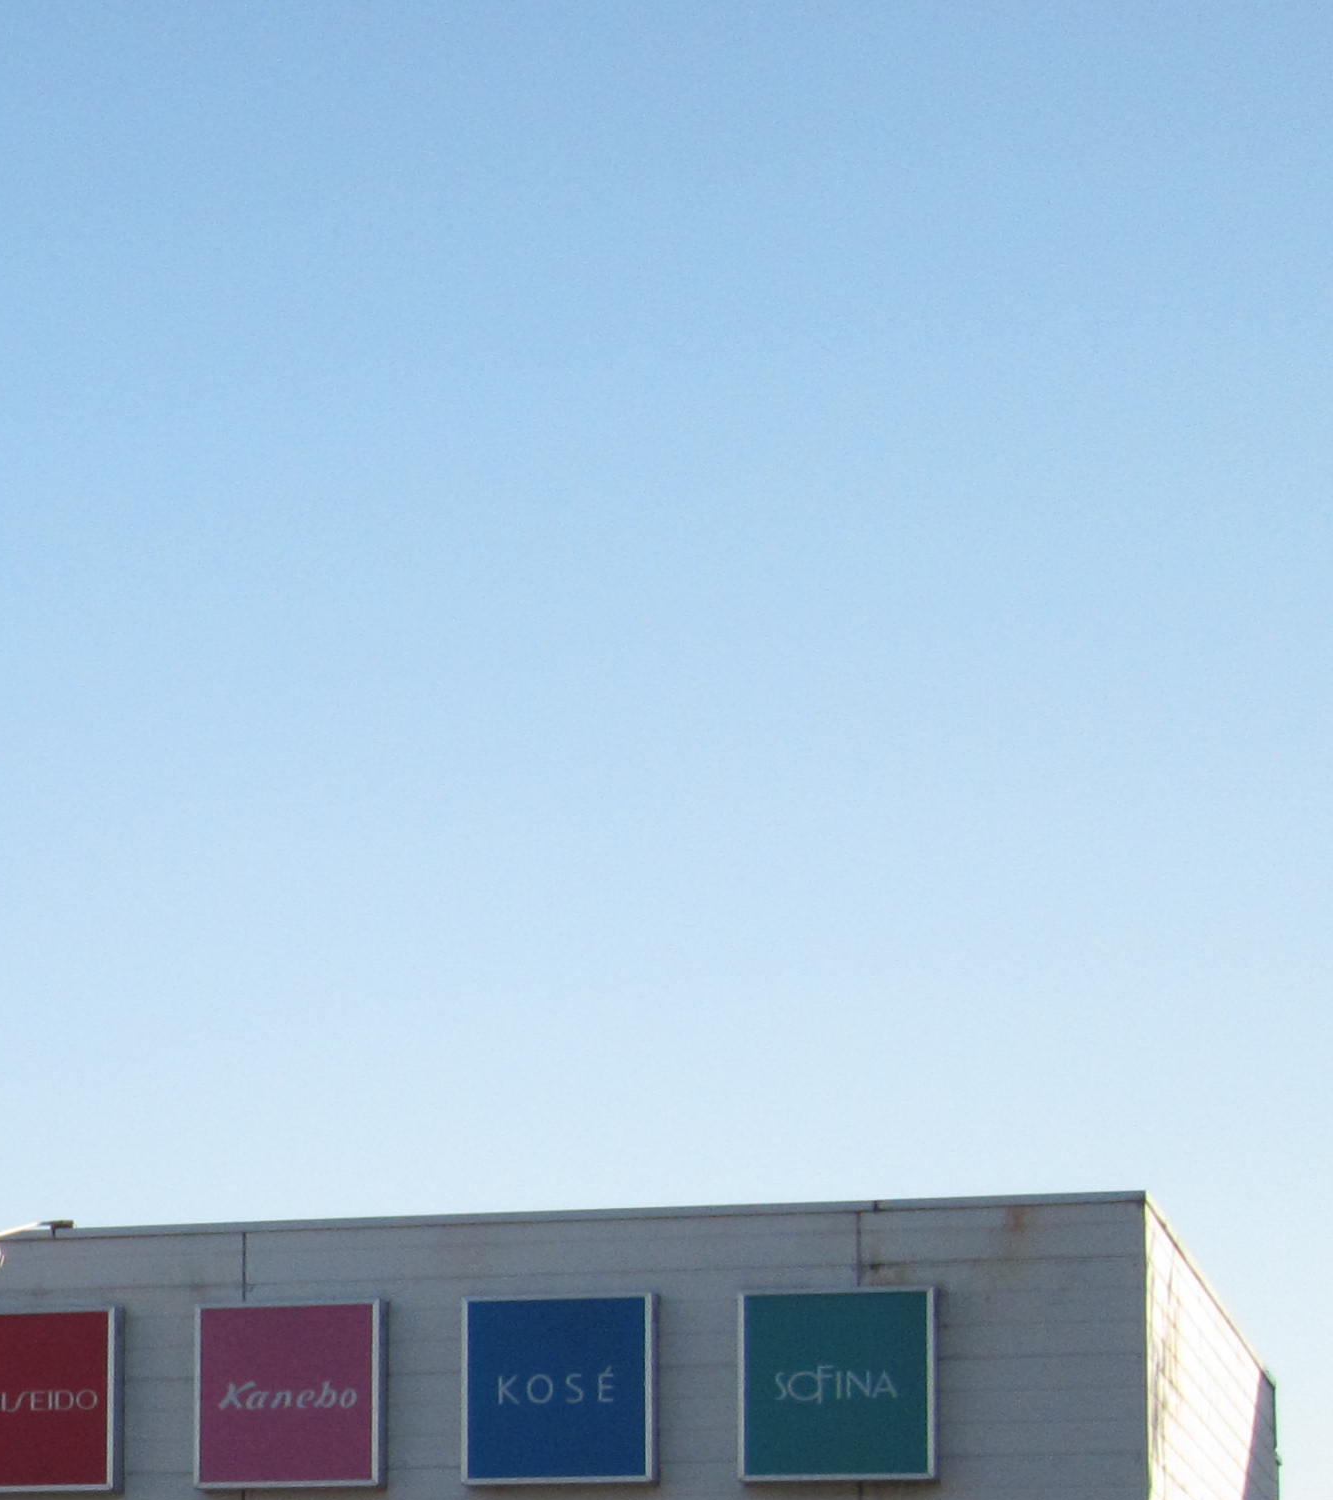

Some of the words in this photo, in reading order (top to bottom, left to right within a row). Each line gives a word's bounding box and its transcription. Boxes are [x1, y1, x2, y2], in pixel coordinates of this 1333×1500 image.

[217, 1379, 359, 1412] Kanebo
[495, 1368, 618, 1406] KOSÉ
[773, 1366, 899, 1402] SOFINA
